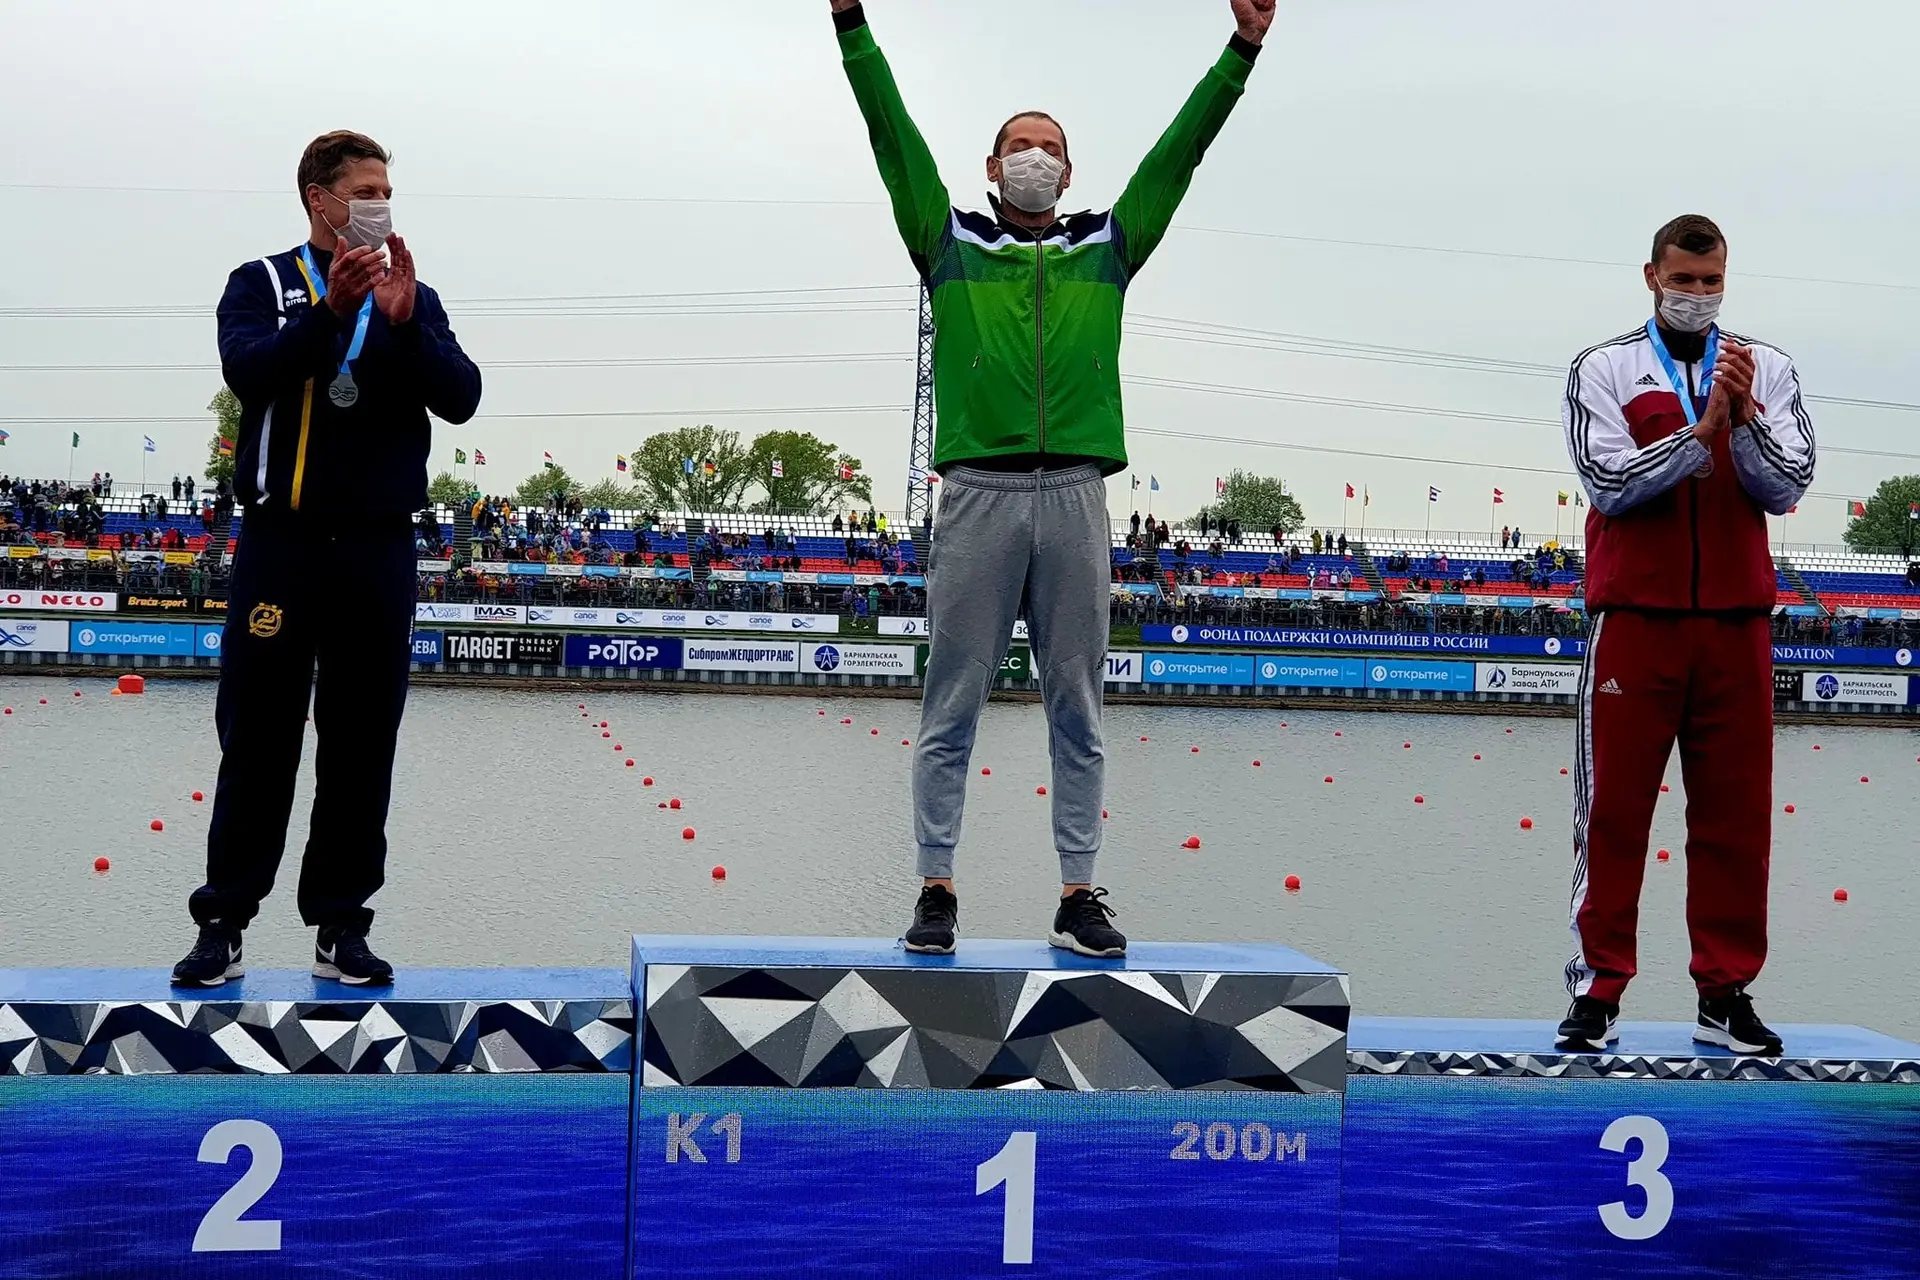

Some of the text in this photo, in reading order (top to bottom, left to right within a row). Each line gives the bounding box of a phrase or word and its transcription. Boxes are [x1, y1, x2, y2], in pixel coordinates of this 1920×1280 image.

[41, 594, 104, 607] NELO
[474, 606, 517, 616] IMAS
[573, 611, 598, 620] canoe
[661, 613, 686, 622] canoe
[749, 616, 773, 624] canoe
[99, 632, 166, 645] открытие
[519, 637, 560, 646] ENERGY
[1199, 629, 1489, 649] ФОНД ПОДДЕРЖКИ ОЛИМПИЙЦЕВ РОССИИ
[412, 640, 437, 655] ЕВА
[447, 635, 515, 659] TARGET
[519, 645, 552, 653] DRINK
[688, 647, 794, 663] СибпромЖЕЛДОРТРАНС
[843, 651, 898, 659] БАРНАУЛЬСКАЯ
[1771, 647, 1835, 660] NDATION
[843, 660, 904, 668] ГОРЭЛЕКТРОСЕТЬ
[1168, 663, 1228, 675] открытие
[1280, 666, 1339, 678] открытие
[1389, 669, 1449, 682] открытие
[1511, 666, 1576, 679] Барнаульский
[1511, 679, 1560, 690] завод АТИ
[1598, 686, 1623, 695] adidas
[1843, 681, 1893, 689] БАРНАУЛЬСКАЯ
[1842, 688, 1898, 697] ГОРЭЛЕКТРОСЕТЬ
[1597, 1115, 1674, 1240] 3
[191, 1119, 283, 1252] 2
[976, 1131, 1037, 1264] 1
